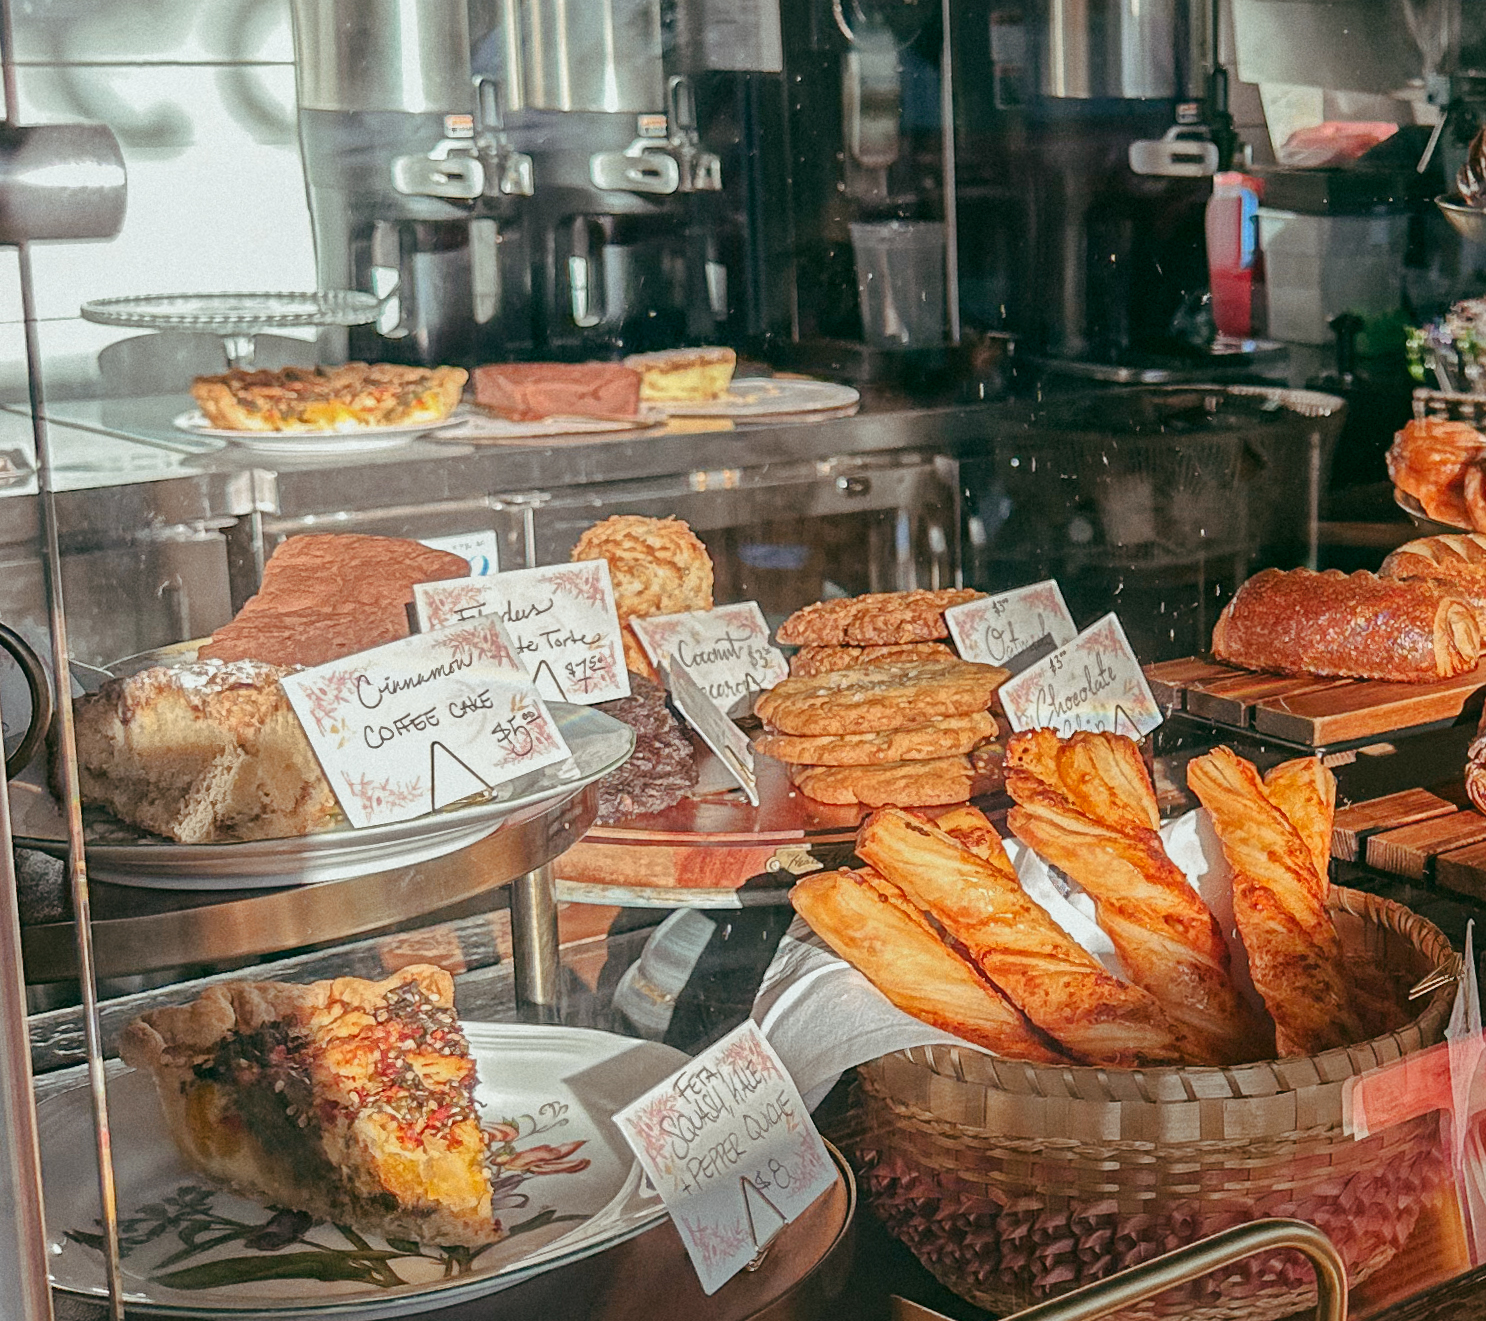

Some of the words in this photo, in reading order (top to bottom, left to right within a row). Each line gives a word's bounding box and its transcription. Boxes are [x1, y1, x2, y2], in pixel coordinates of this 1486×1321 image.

[679, 631, 753, 668] Coconut
[356, 653, 473, 709] Cinnamon
[1037, 652, 1117, 727] Chocolate
[364, 707, 440, 749] COFFEE
[449, 689, 494, 719] CAKE
[686, 1132, 747, 1192] PEPPER
